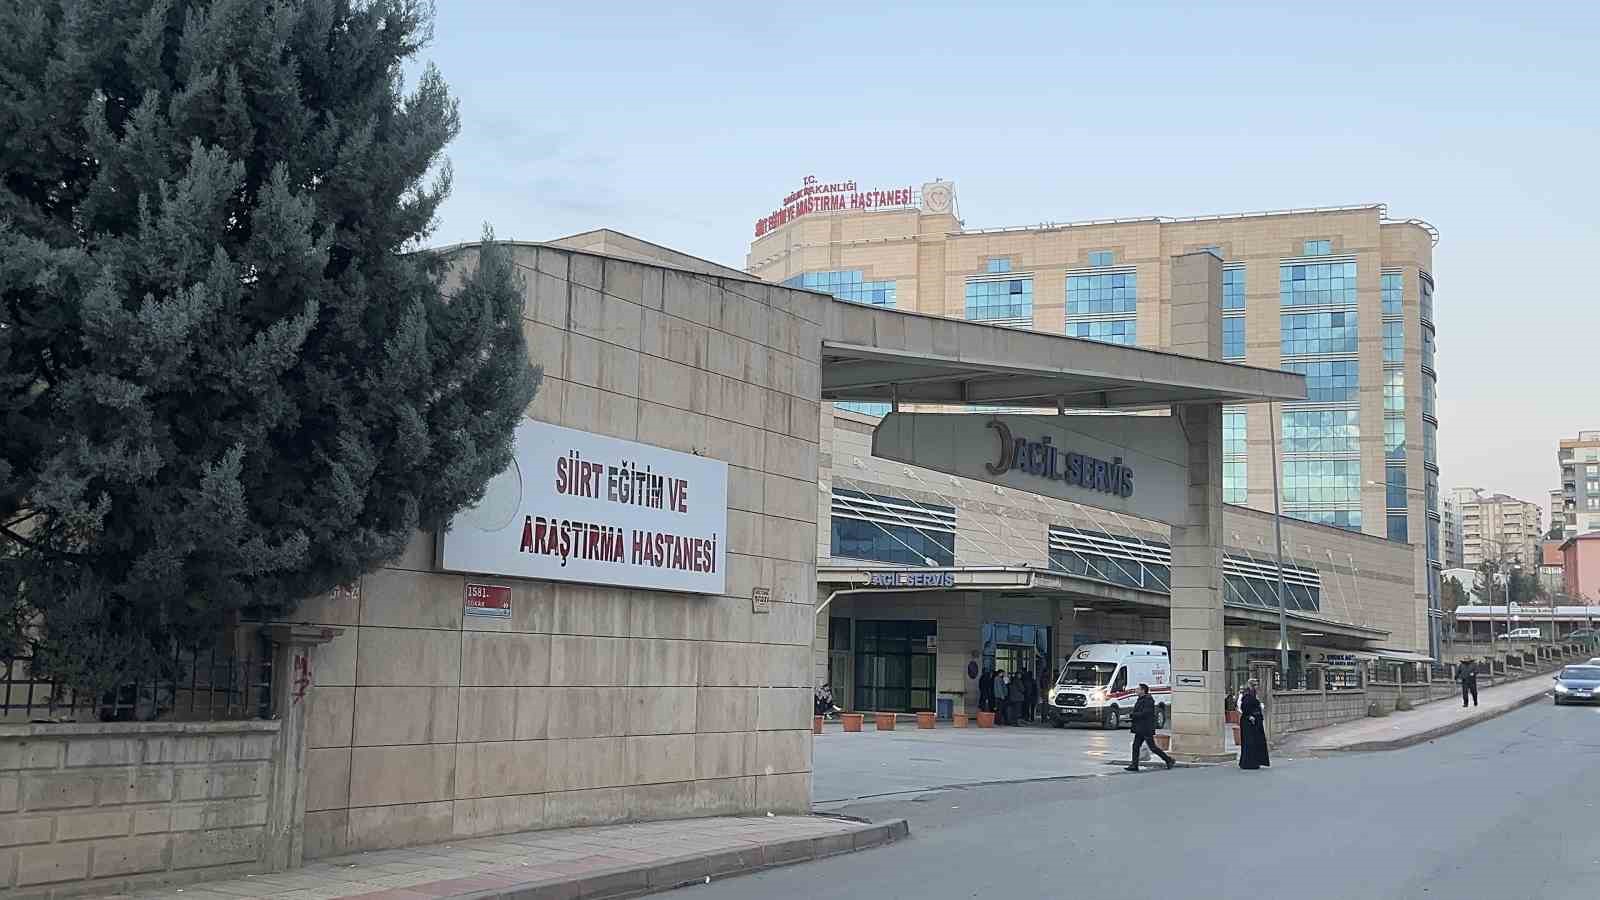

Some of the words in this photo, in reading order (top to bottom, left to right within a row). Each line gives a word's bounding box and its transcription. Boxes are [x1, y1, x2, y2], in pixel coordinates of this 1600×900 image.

[803, 175, 818, 186] T.C.
[850, 185, 912, 209] HASTANESİ
[555, 450, 603, 499] SİİRT
[607, 460, 664, 510] EĞİTİM
[668, 477, 688, 513] VE
[1010, 435, 1062, 481] ACİL
[1064, 452, 1134, 498] SERVİS
[520, 515, 625, 567] ARAŞTIRMA
[631, 533, 716, 574] HASTANESİ
